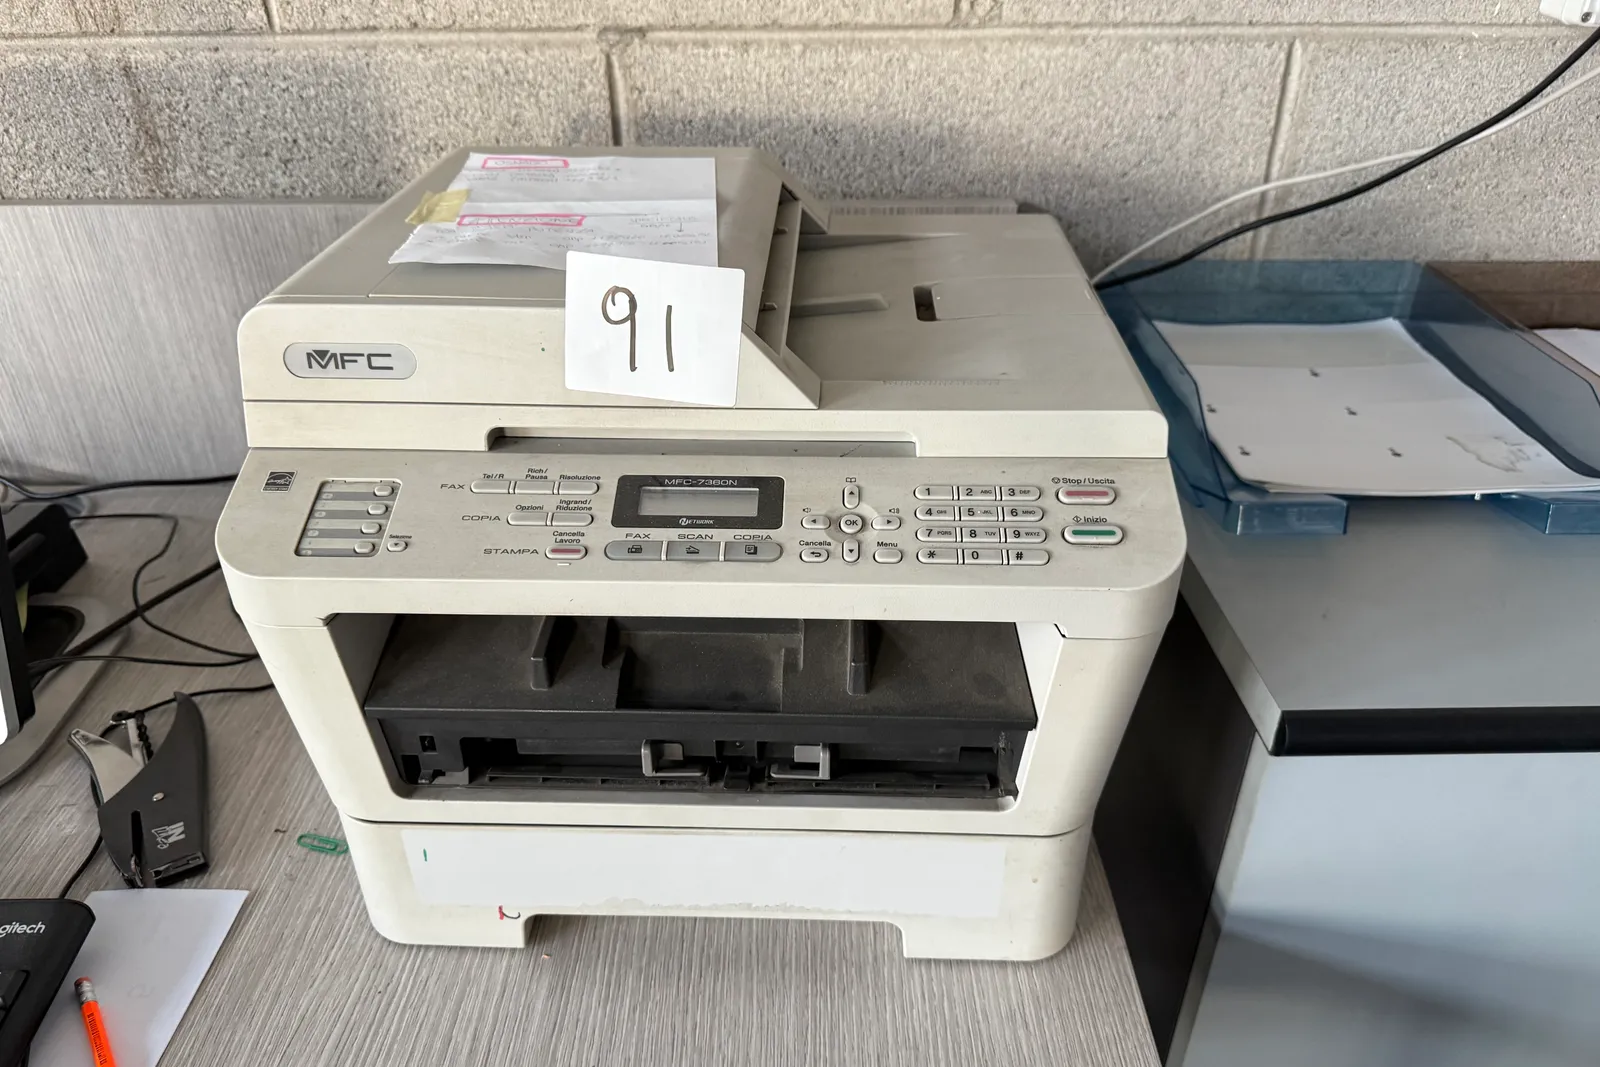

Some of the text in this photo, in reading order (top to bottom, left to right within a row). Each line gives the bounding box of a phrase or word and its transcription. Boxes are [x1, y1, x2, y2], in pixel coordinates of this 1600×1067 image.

[602, 285, 675, 372] 91
[306, 350, 394, 370] MFC
[664, 478, 738, 486] MFC-7360N
[925, 488, 931, 496] 1
[965, 488, 973, 496] 2
[1008, 488, 1016, 496] 3
[925, 508, 933, 516] 4
[967, 508, 975, 516] 5
[1010, 508, 1018, 517] 6
[926, 529, 933, 537] 7
[969, 529, 977, 538] 8
[1013, 530, 1020, 538] 9
[971, 551, 979, 560] 0
